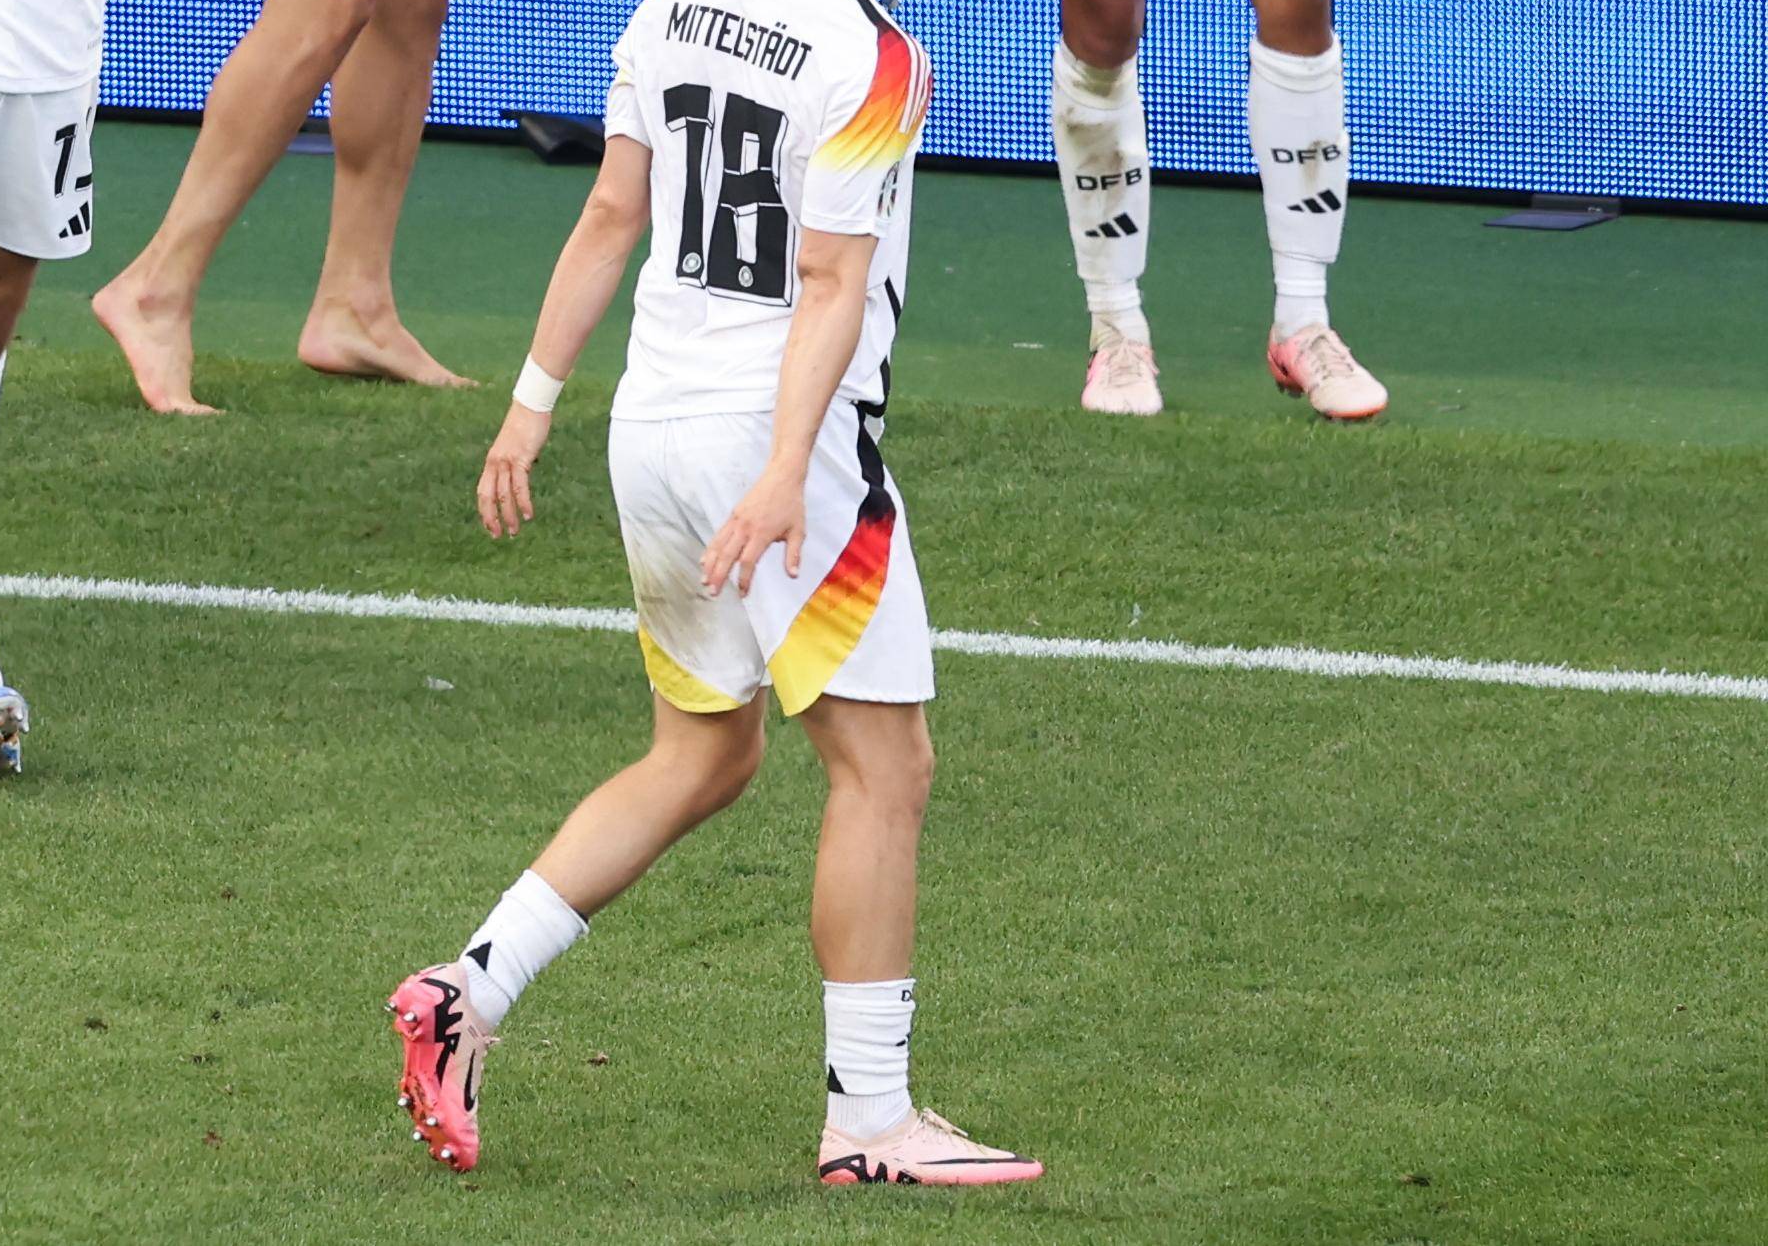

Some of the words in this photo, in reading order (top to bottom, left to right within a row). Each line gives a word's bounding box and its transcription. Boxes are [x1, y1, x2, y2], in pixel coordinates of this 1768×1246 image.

[666, 2, 813, 81] MITTELSTÄDT
[1076, 168, 1143, 191] DFB
[1271, 143, 1341, 166] DFB
[663, 82, 793, 309] 18
